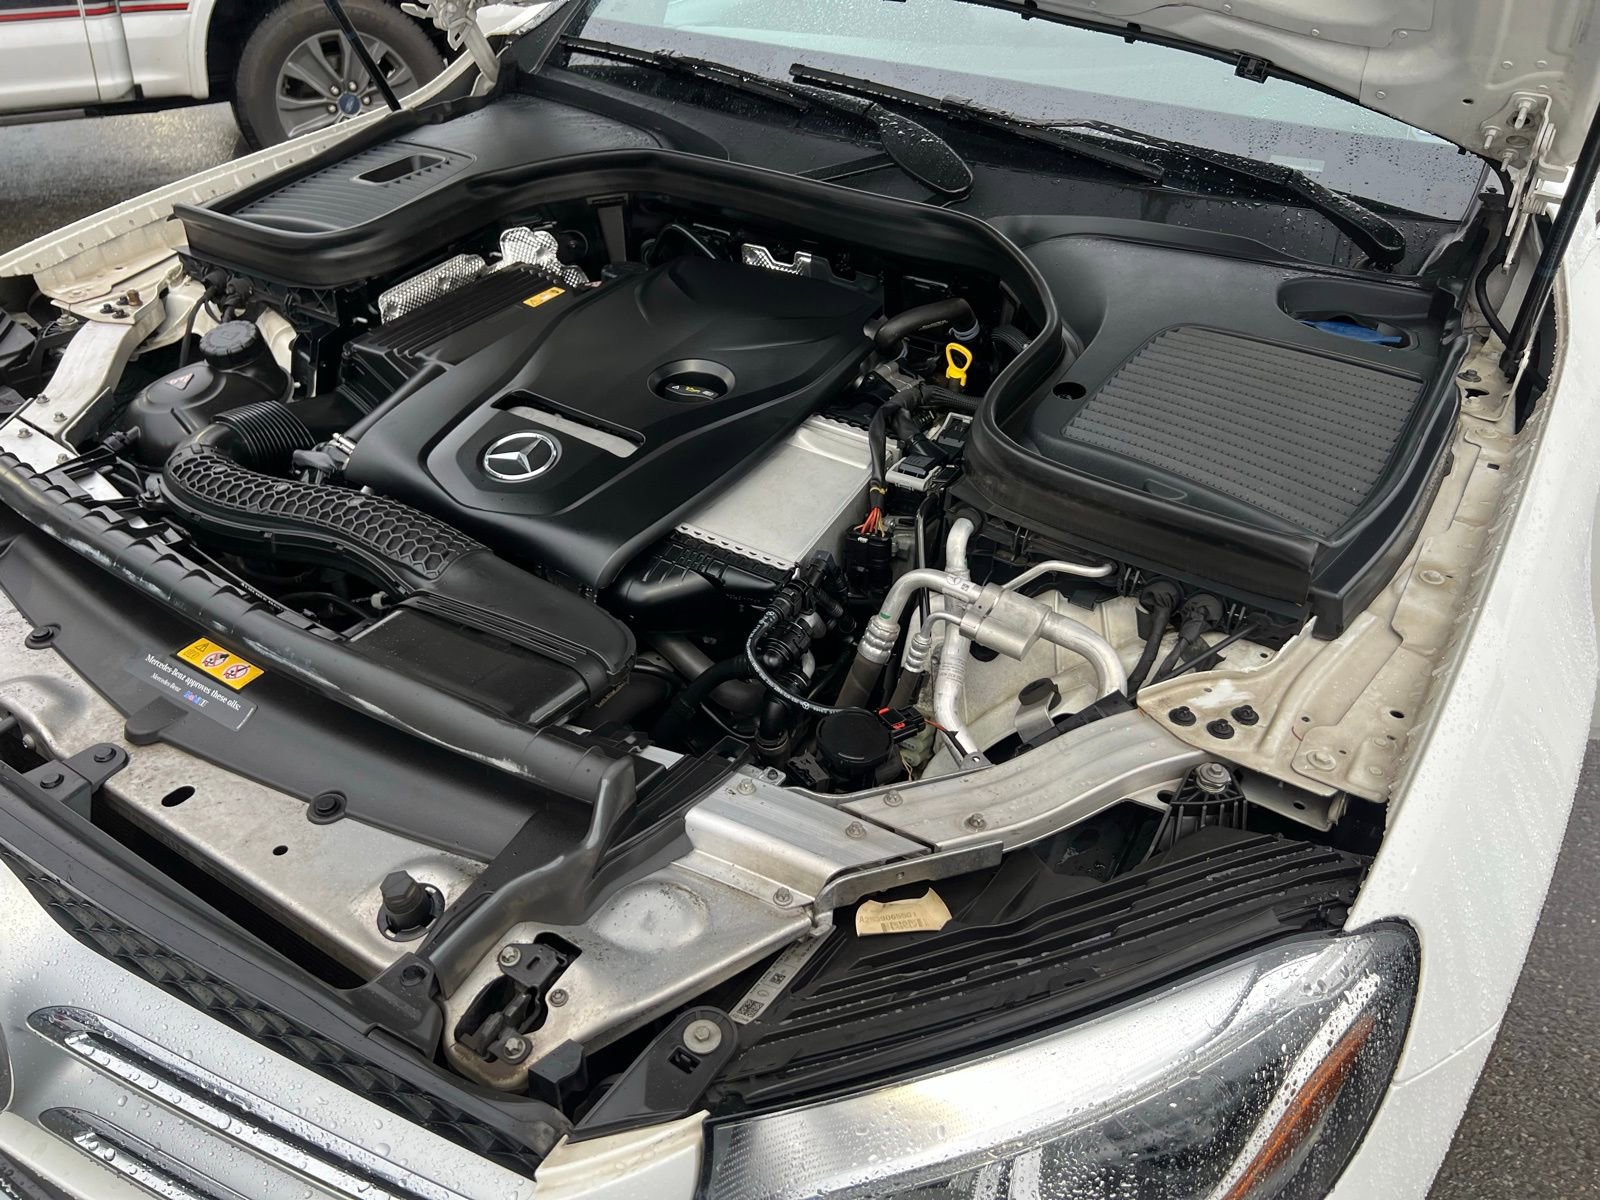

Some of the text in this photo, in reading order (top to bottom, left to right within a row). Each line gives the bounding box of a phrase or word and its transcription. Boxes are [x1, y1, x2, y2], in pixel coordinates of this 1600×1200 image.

[185, 675, 211, 695] approves
[210, 689, 228, 704] these
[226, 699, 242, 711] oils:
